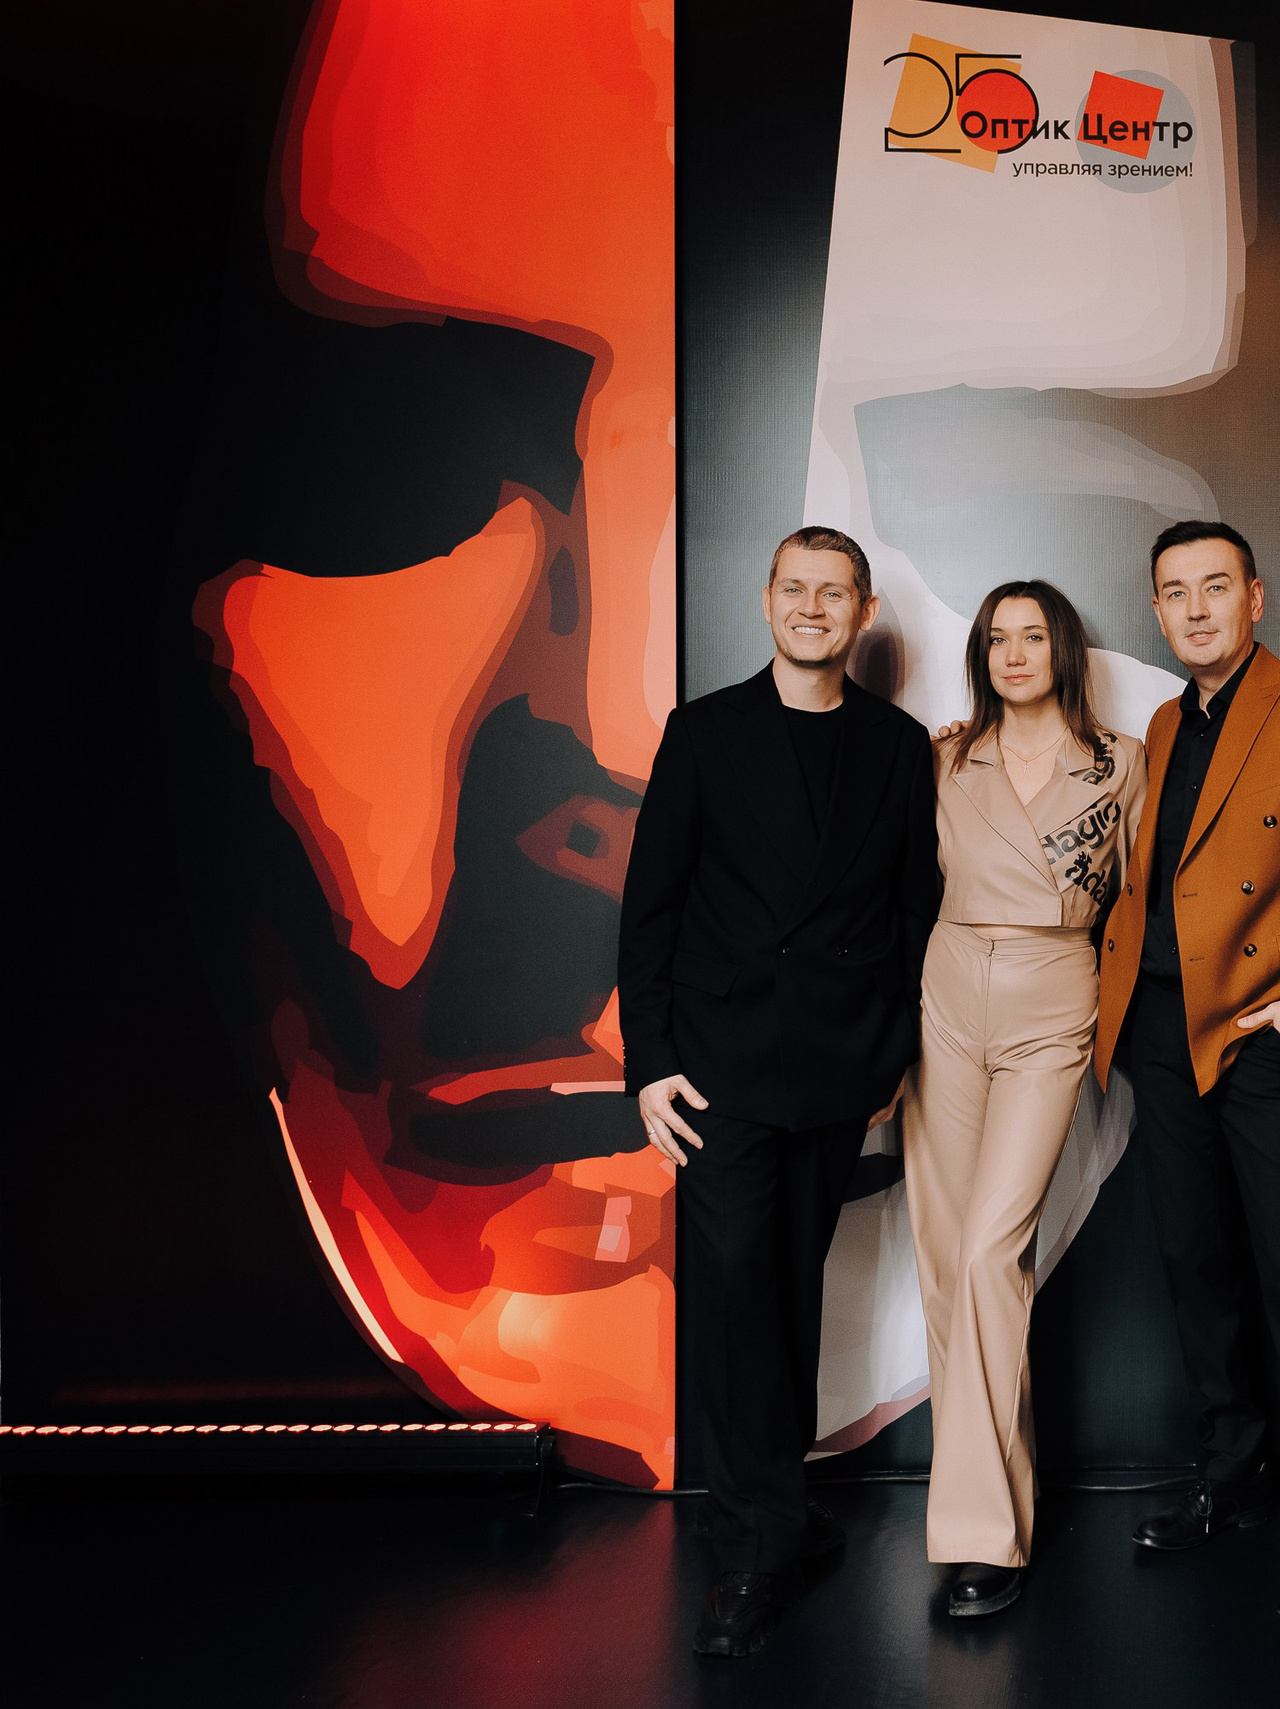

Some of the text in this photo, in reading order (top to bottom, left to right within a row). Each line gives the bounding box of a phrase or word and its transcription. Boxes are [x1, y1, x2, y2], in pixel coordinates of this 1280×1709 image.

[883, 51, 1040, 155] 25
[960, 110, 1194, 149] Оптик Центр
[1012, 161, 1194, 178] управляя зрением!
